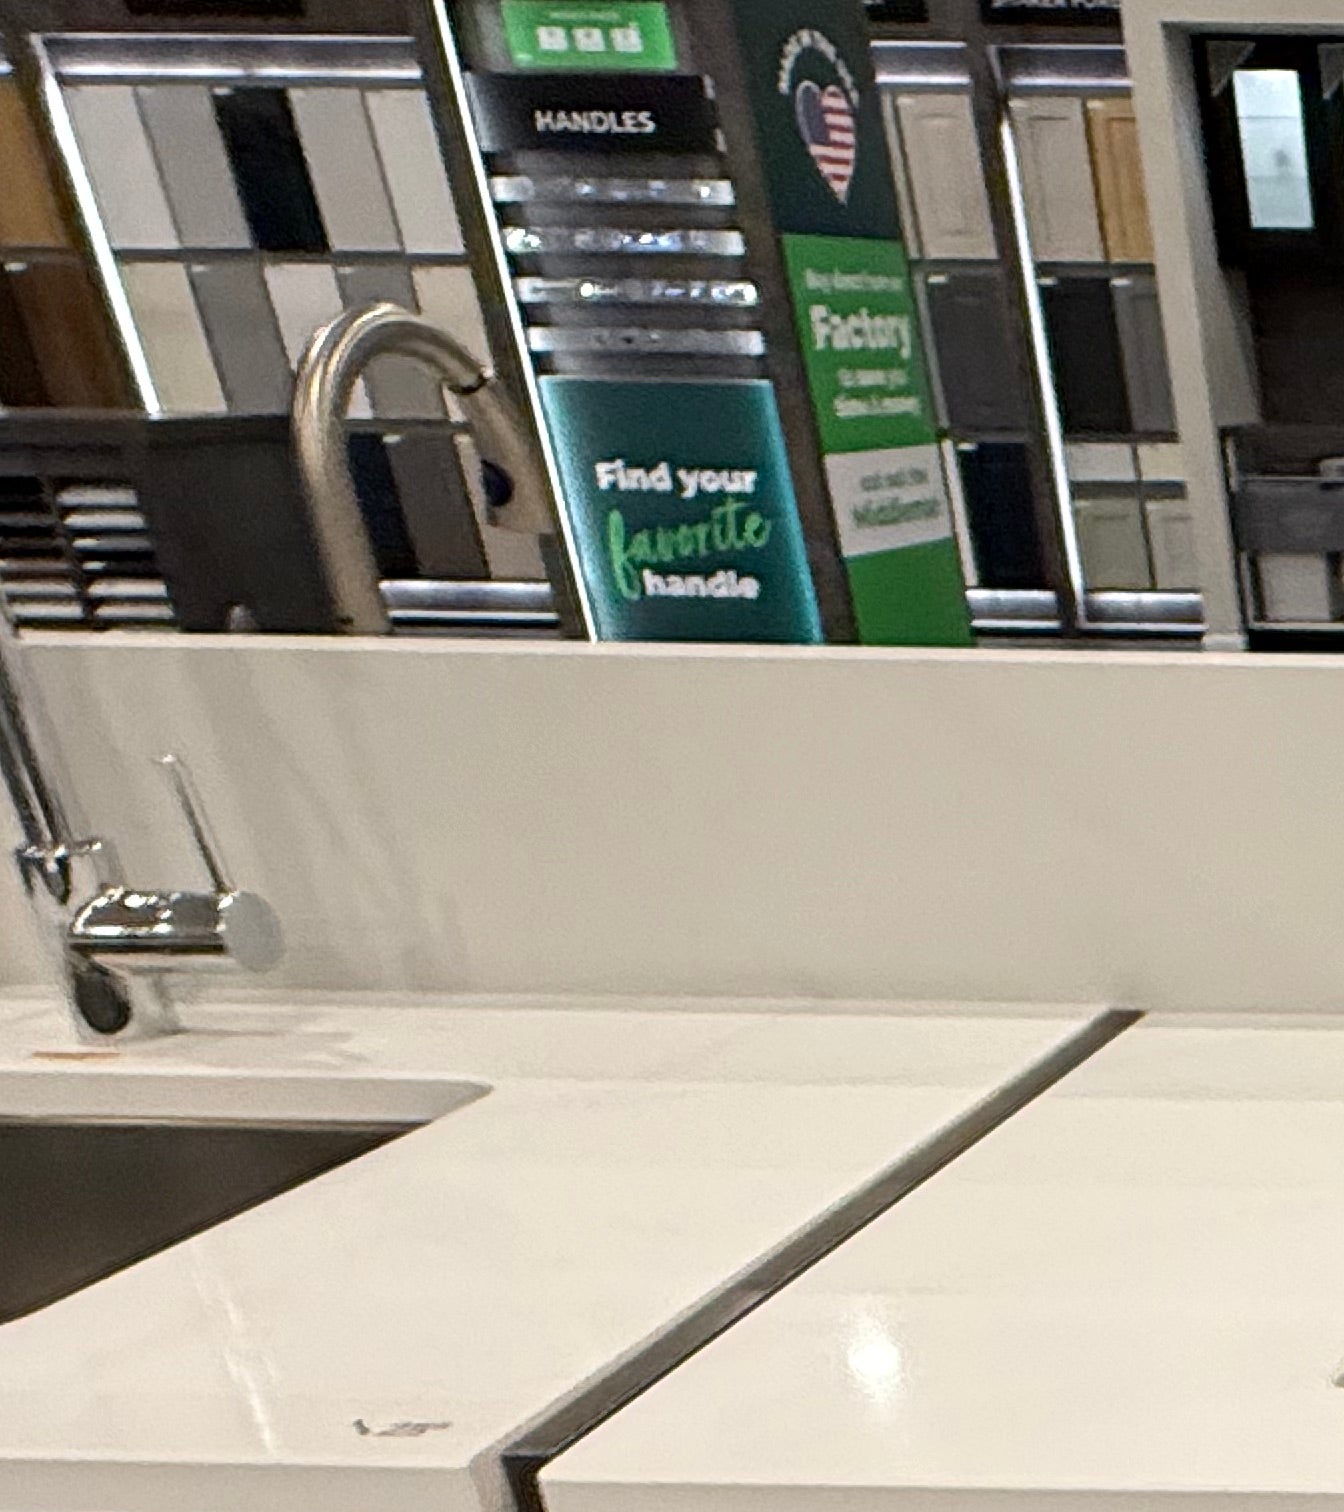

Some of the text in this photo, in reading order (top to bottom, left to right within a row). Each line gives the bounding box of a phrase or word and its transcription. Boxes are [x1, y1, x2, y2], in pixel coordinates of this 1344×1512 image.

[534, 110, 656, 134] HANDLES
[810, 304, 911, 358] Factory
[595, 459, 757, 499] Find your
[609, 497, 771, 600] favorite
[643, 568, 761, 599] handle
